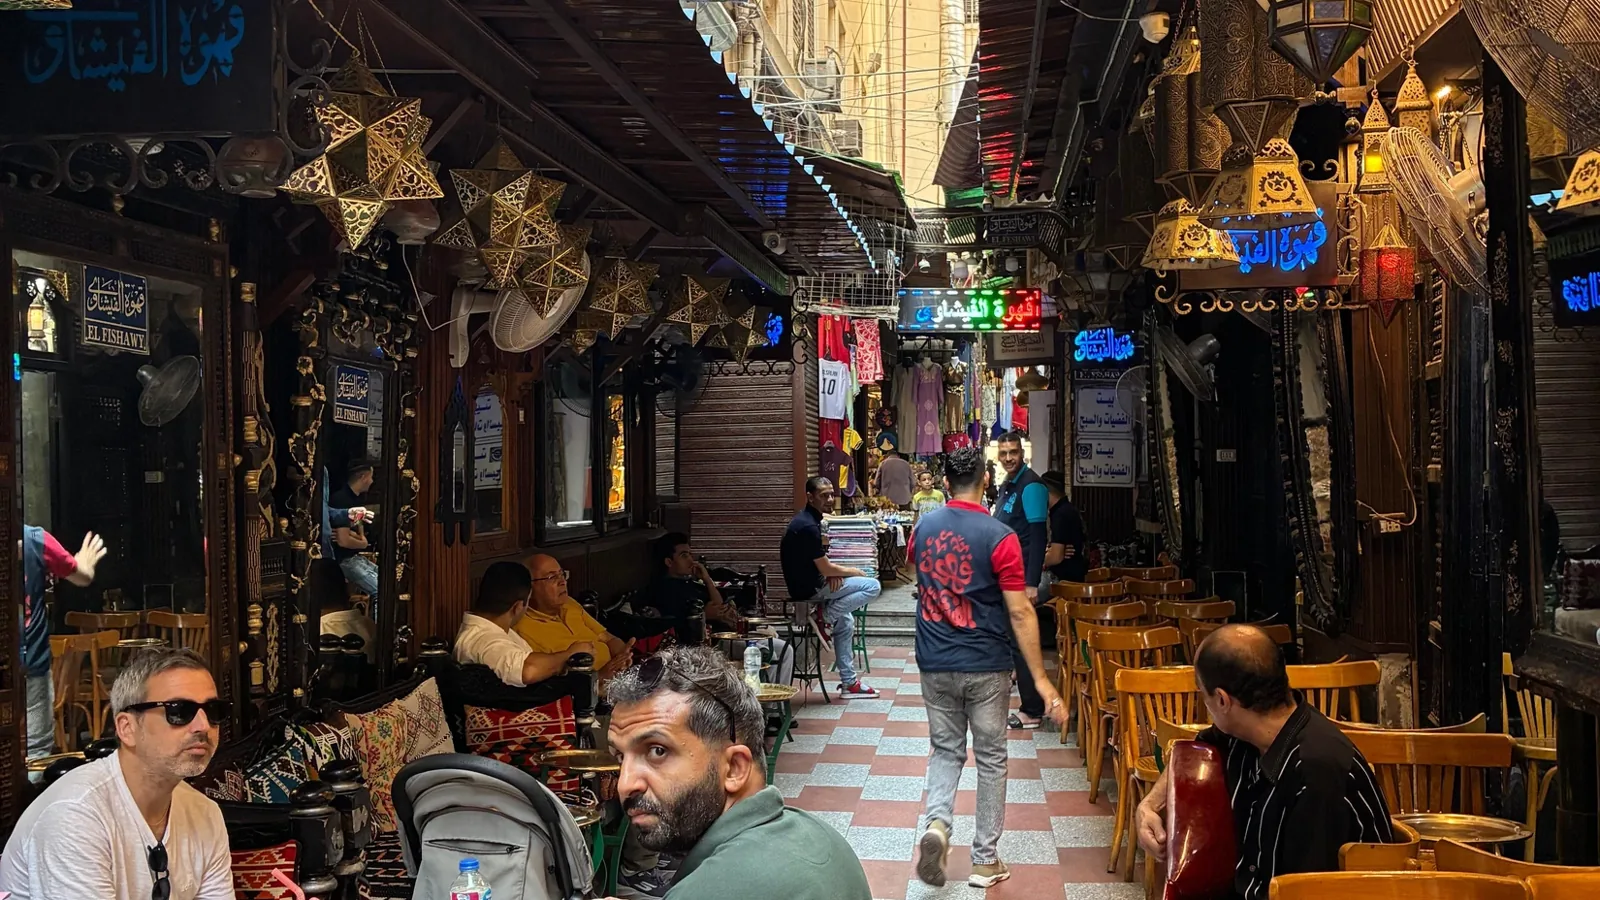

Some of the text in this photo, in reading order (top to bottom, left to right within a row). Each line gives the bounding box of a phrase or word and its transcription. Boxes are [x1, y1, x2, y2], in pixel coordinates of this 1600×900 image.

[993, 296, 1034, 322] قهوة
[87, 325, 145, 349] EL FISHAWY
[821, 377, 836, 396] 10
